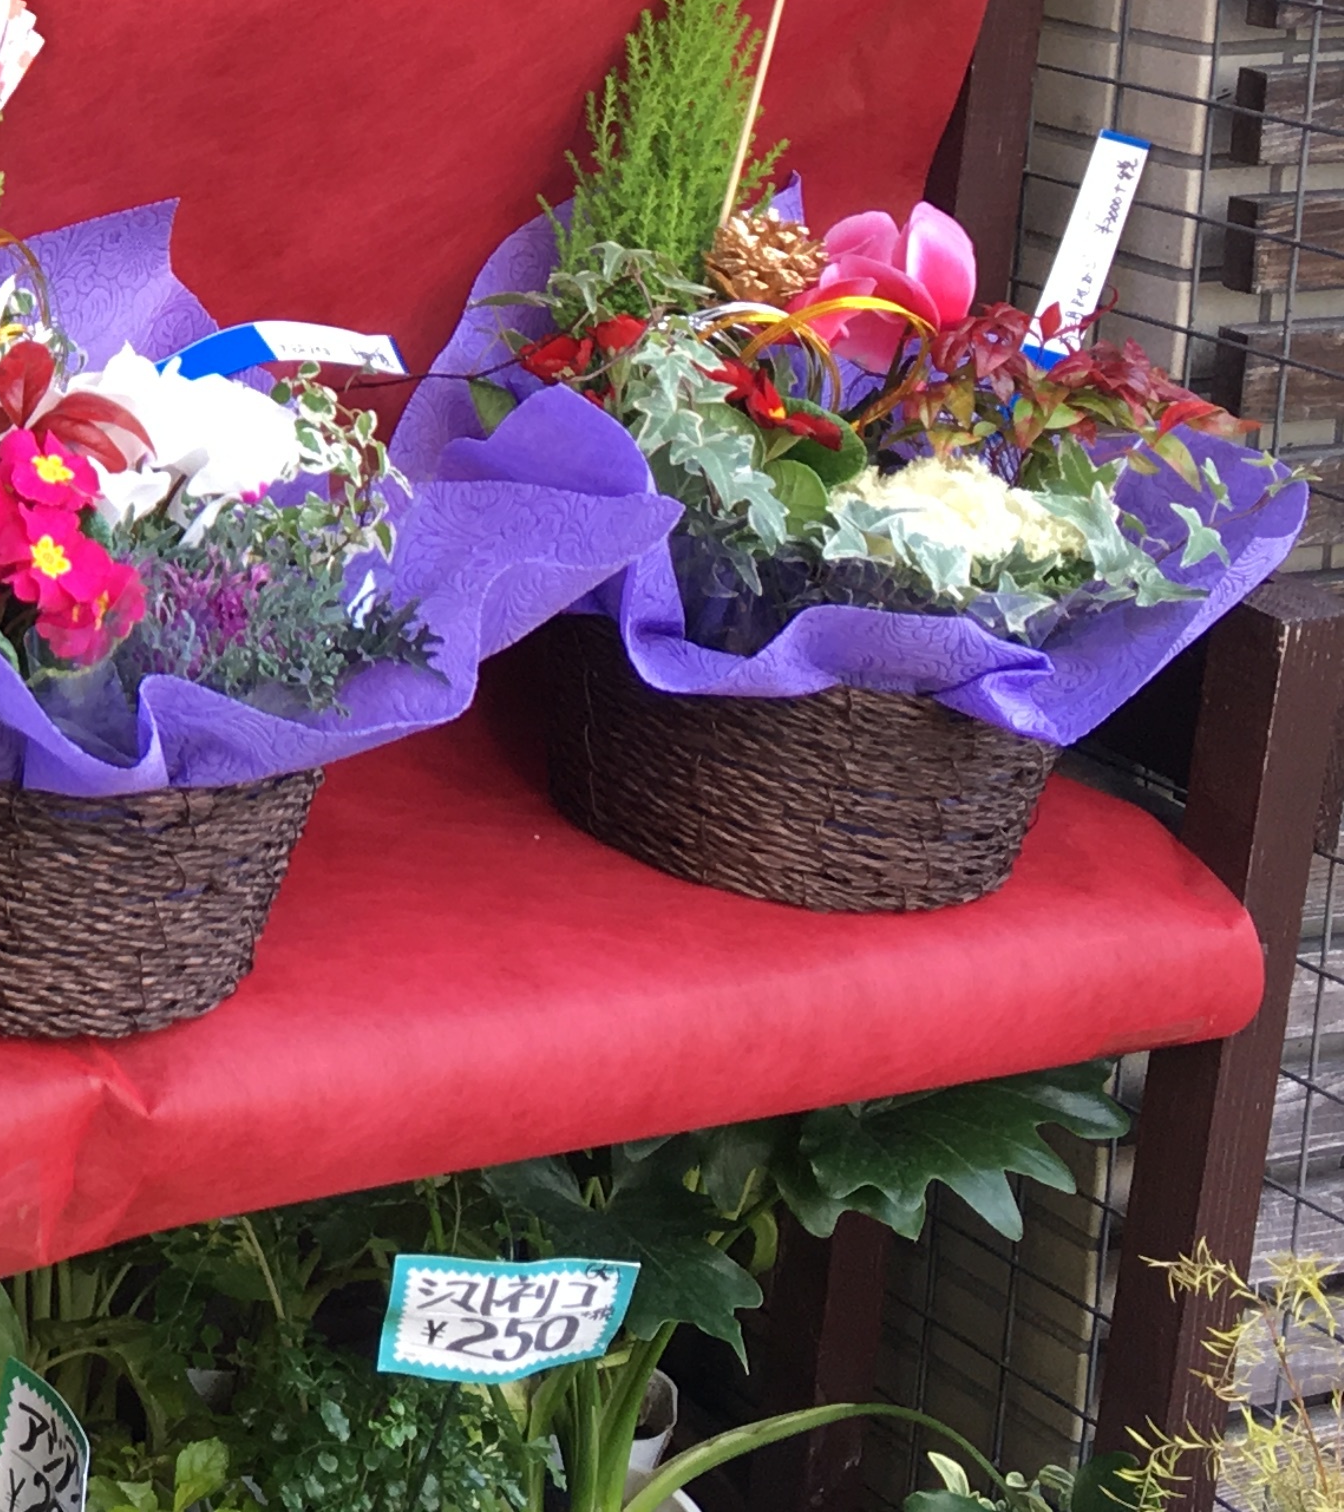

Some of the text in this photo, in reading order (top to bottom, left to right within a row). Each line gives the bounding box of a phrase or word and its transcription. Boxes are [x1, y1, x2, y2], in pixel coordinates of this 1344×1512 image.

[416, 1276, 599, 1318] シマトネリコ
[420, 1314, 580, 1362] ¥250
